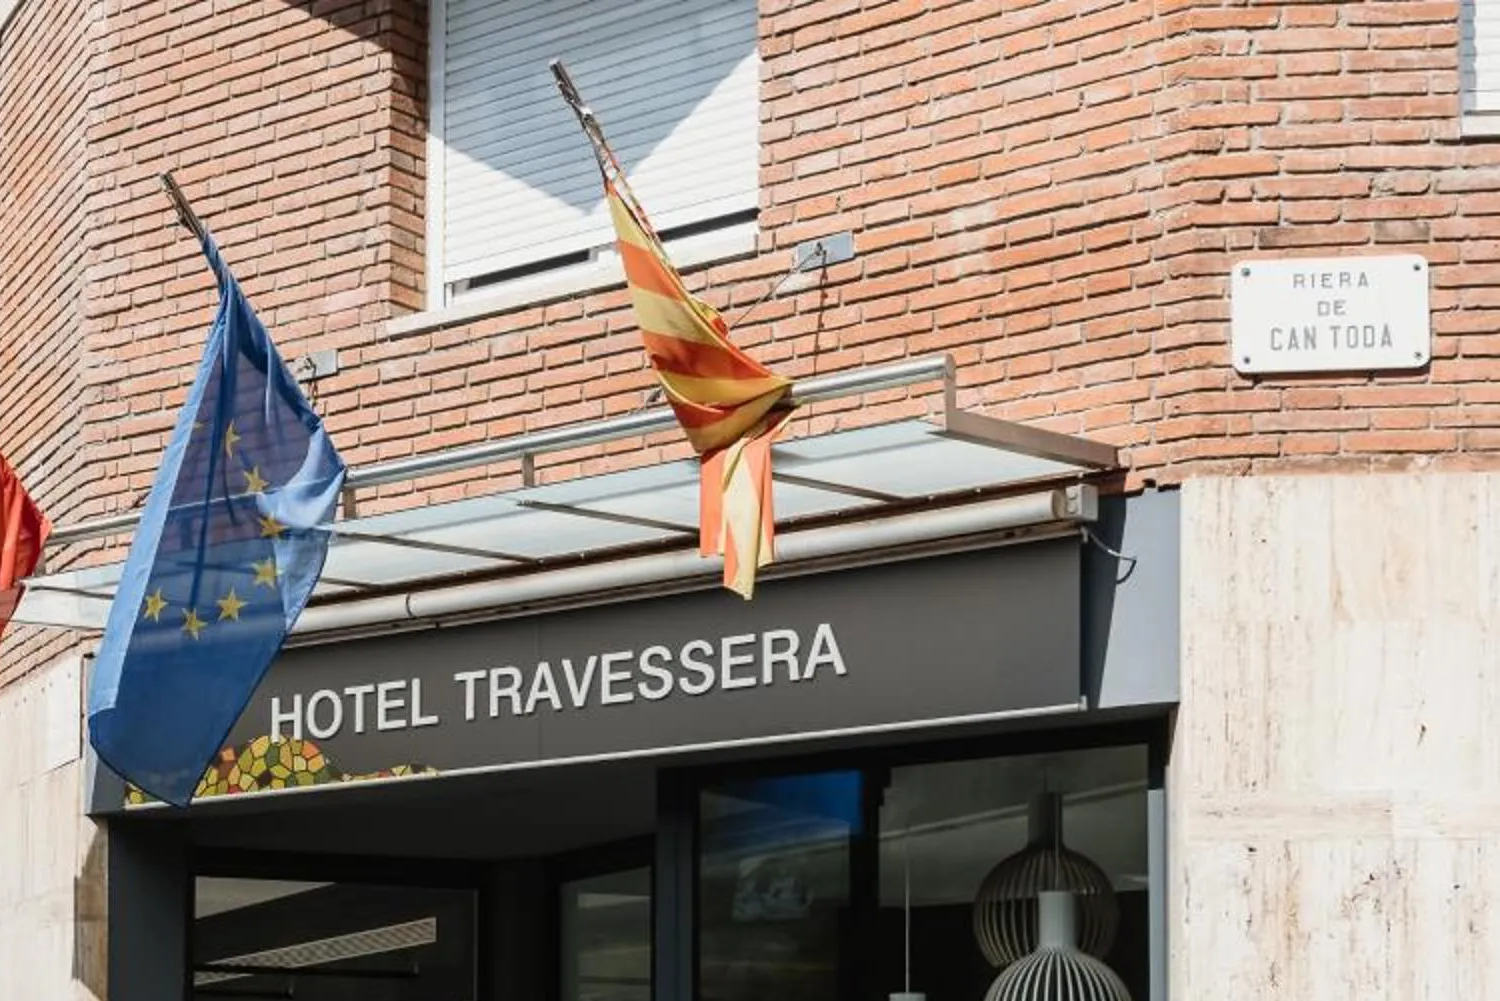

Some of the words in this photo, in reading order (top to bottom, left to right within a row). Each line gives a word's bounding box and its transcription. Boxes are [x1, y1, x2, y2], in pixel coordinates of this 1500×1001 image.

[1293, 271, 1369, 289] RIERA
[1317, 300, 1347, 317] DE
[1270, 326, 1317, 351] CAN
[1329, 325, 1393, 349] TODA
[270, 678, 439, 744] HOTEL
[454, 623, 847, 721] TRAVESSERA
